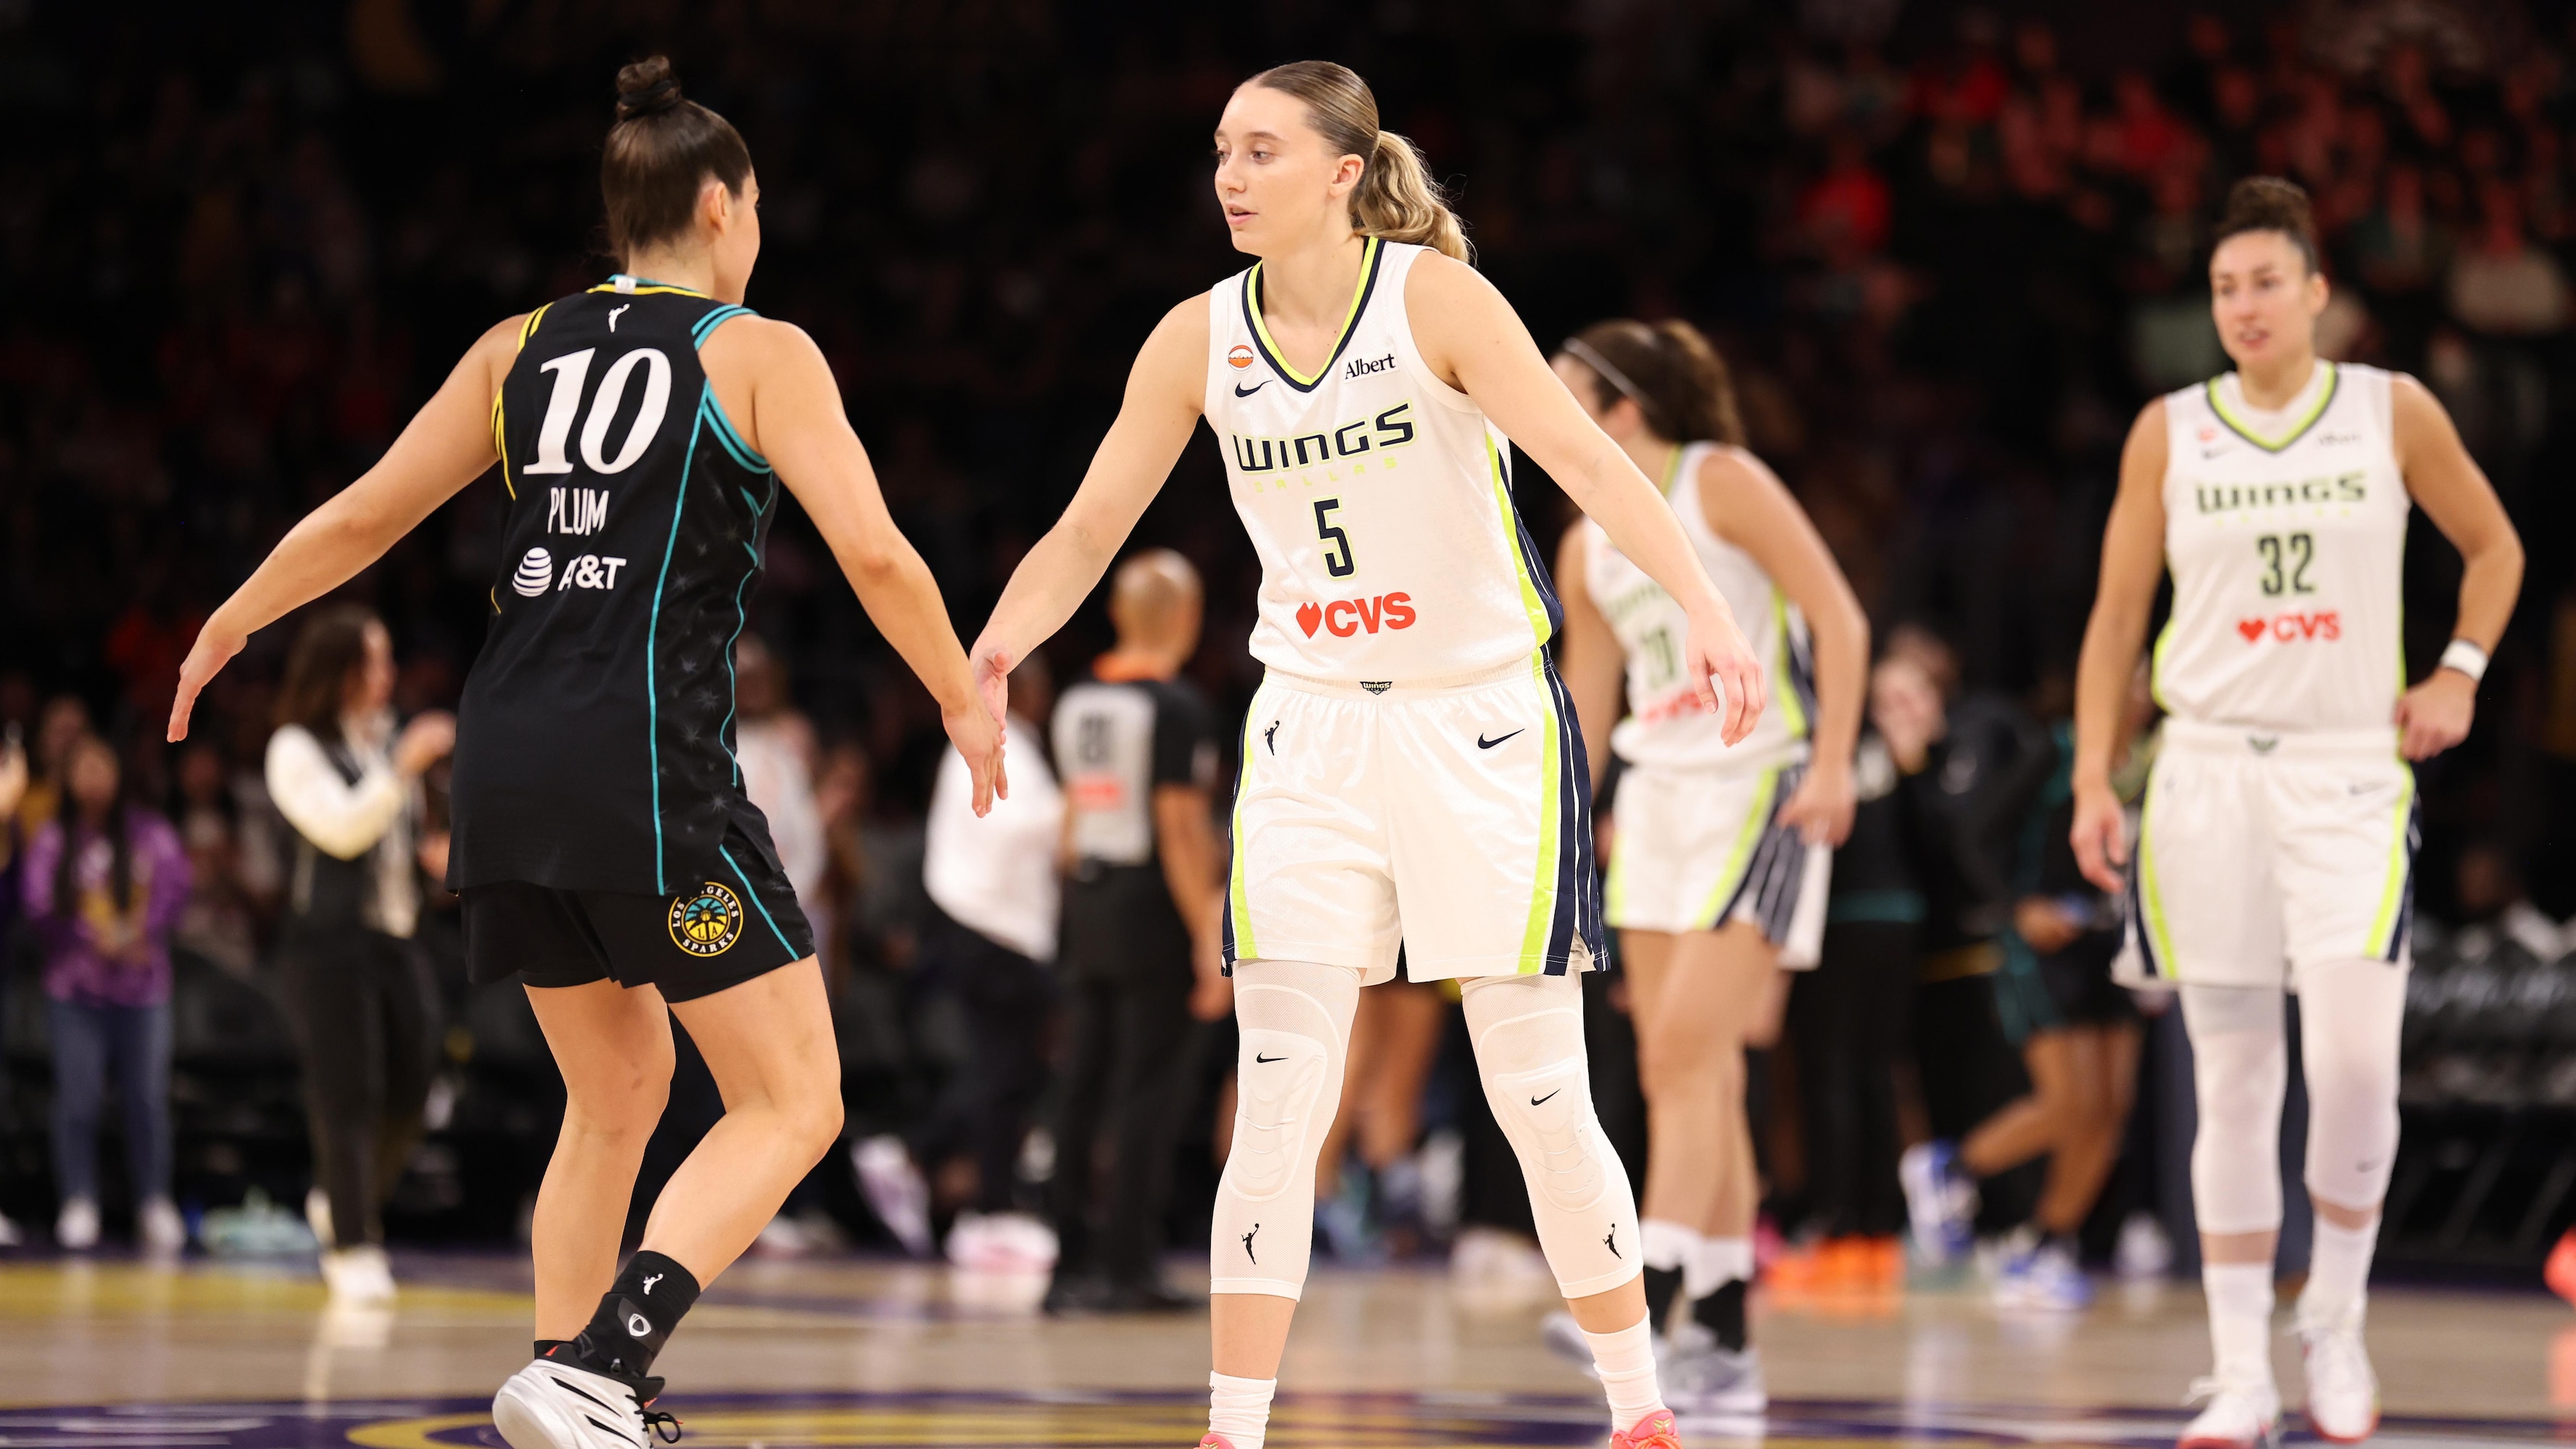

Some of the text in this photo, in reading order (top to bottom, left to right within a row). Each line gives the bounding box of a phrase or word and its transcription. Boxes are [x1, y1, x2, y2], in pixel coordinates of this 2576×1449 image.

[1345, 354, 1396, 380] Albert
[522, 347, 672, 475] 10
[1231, 400, 1417, 475] WINGS
[548, 488, 609, 536] PLUM
[2196, 472, 2367, 514] WINGS
[1312, 496, 1357, 579] 5
[557, 555, 627, 591] A&T
[2257, 533, 2316, 597] 32
[1325, 592, 1416, 638] CVS
[2273, 611, 2341, 643] CVS
[672, 885, 739, 927] LOS GELES
[683, 932, 733, 953] SPARKS
